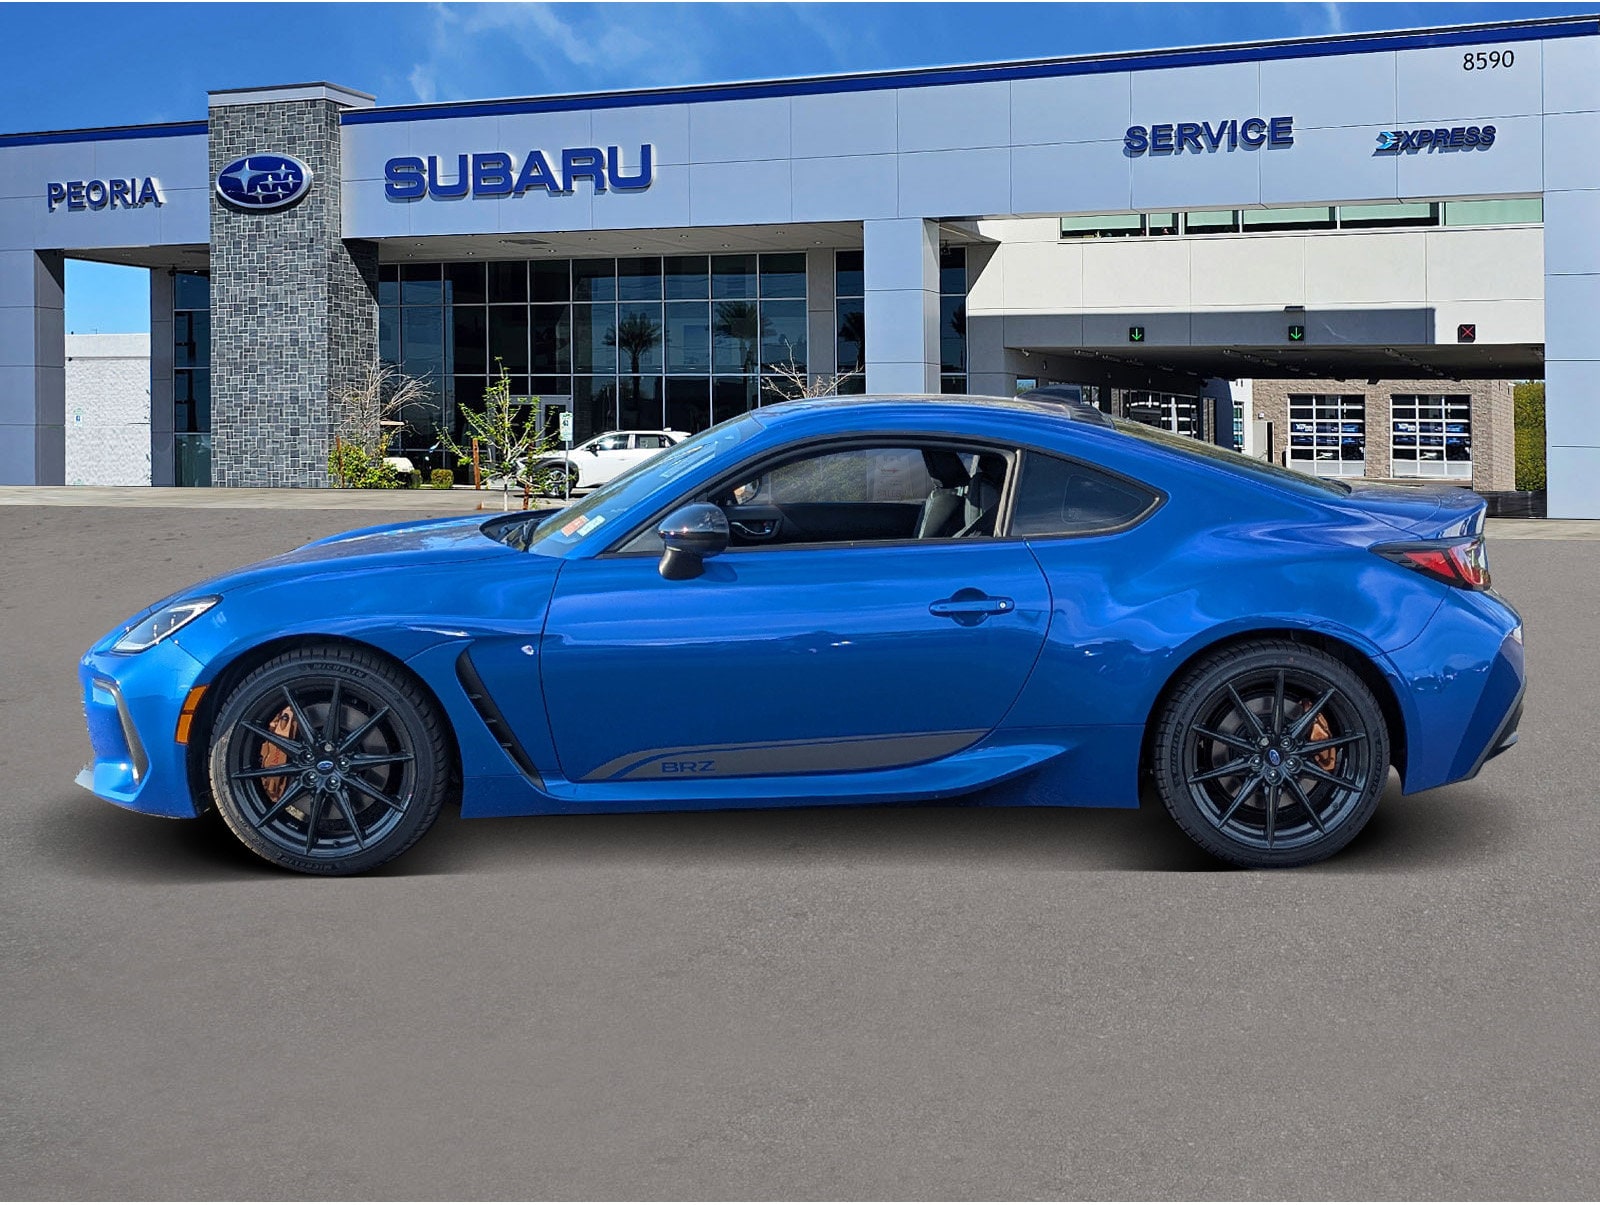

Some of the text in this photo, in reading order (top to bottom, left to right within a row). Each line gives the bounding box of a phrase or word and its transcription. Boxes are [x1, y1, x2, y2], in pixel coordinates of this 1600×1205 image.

[1463, 50, 1514, 71] 8590
[1125, 116, 1293, 151] SERVICE
[1376, 125, 1497, 150] EXPRESS
[384, 144, 651, 199] SUBARU
[47, 177, 162, 209] PEORIA
[661, 760, 716, 773] BRZ
